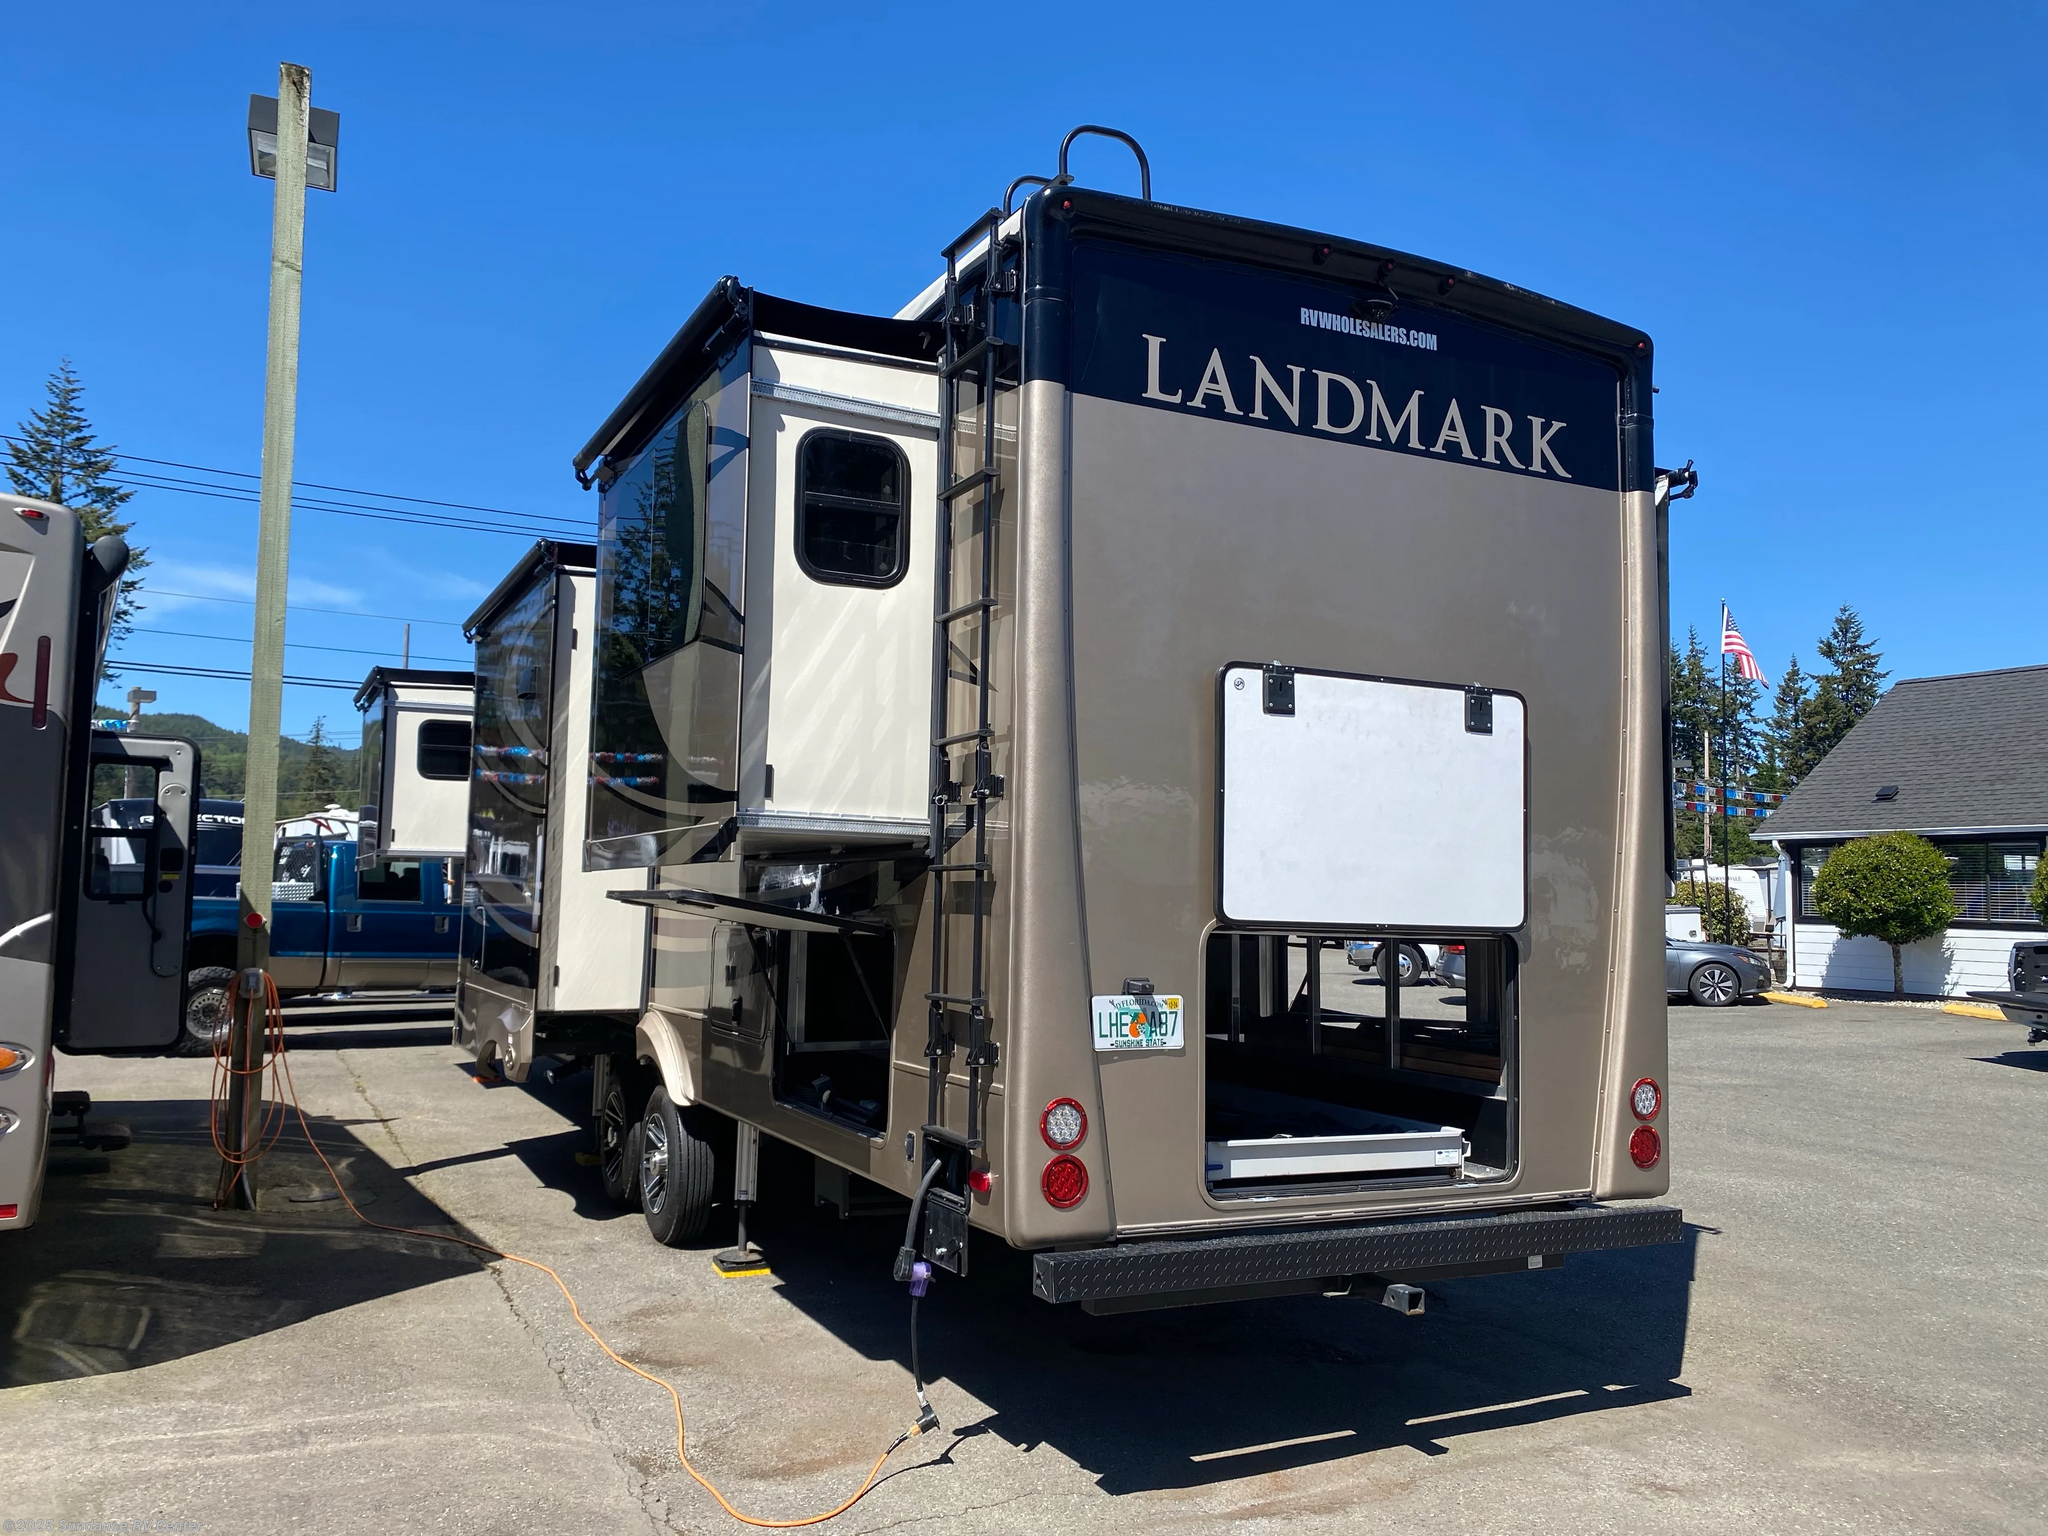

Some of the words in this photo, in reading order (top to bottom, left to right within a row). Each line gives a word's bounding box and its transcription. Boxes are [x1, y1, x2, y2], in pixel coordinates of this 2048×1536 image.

[1300, 307, 1437, 351] RVWHOLESALERS.COM
[1142, 333, 1572, 479] LANDMARK
[1098, 1012, 1129, 1038] LHE
[1114, 1038, 1144, 1048] SUNSHINE
